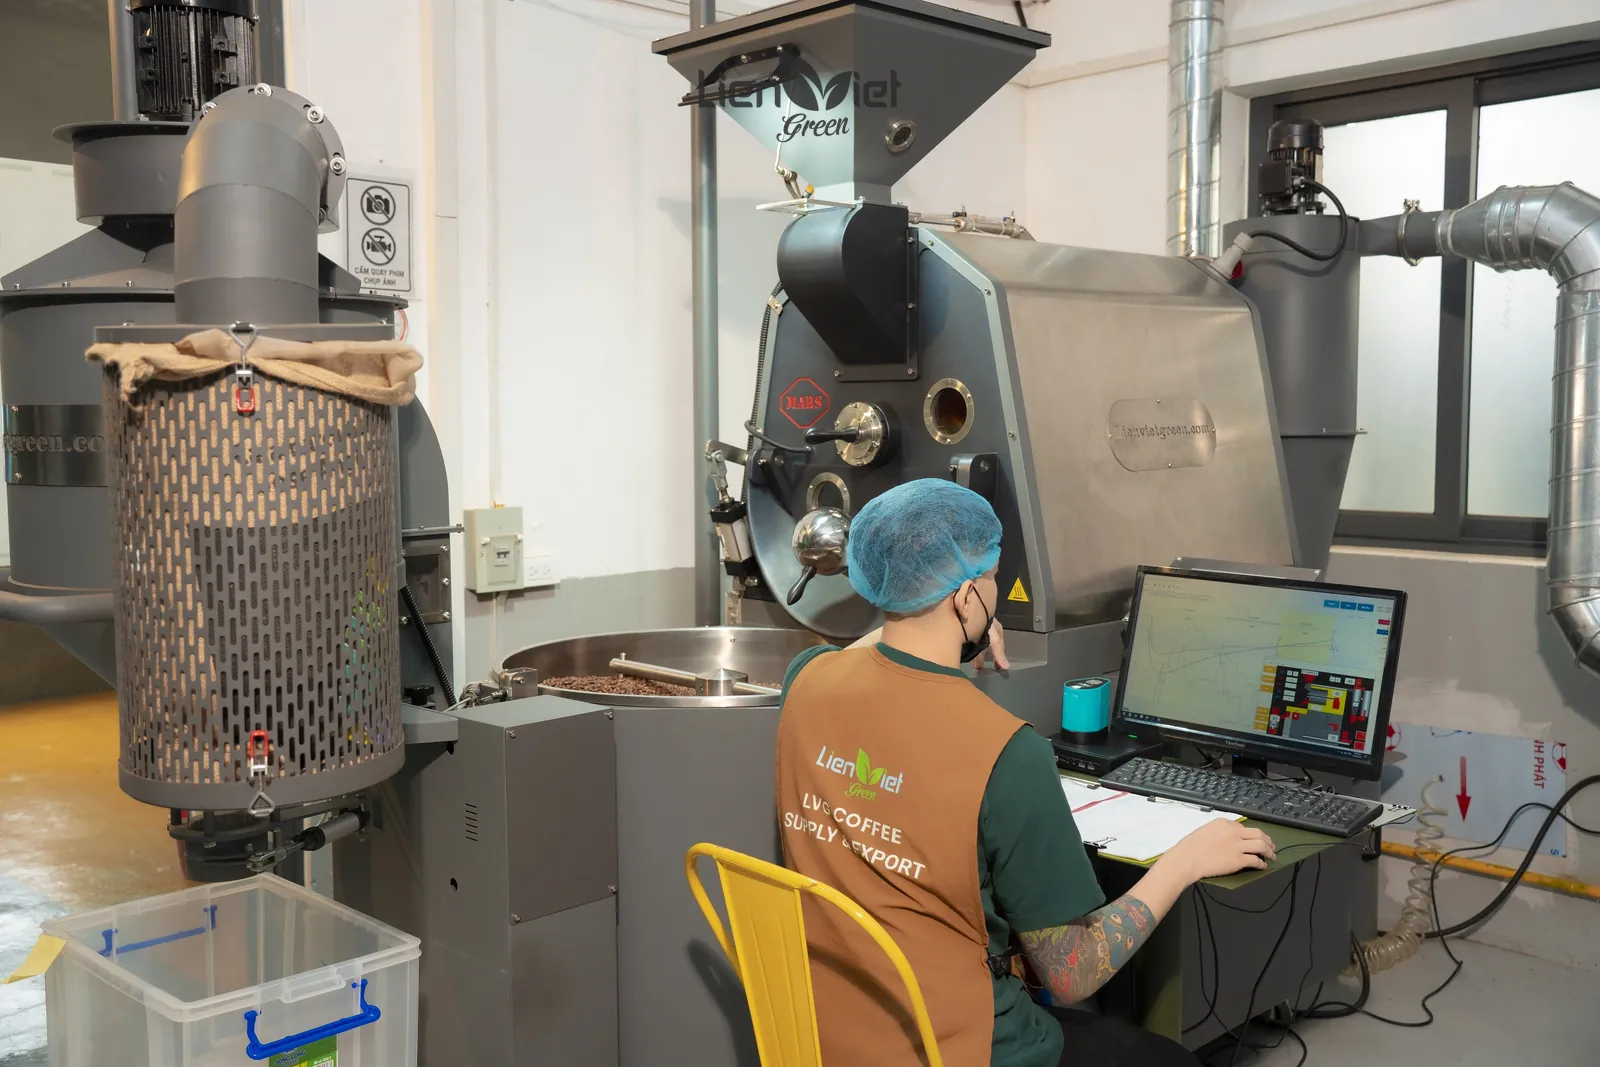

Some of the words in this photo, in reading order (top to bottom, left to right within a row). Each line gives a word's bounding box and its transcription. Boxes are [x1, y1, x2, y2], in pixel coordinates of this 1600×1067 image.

[776, 113, 850, 143] Green
[785, 395, 823, 410] MARS
[1533, 756, 1547, 789] PHÁT
[844, 783, 877, 800] Green
[833, 807, 902, 845] COFFEE
[784, 812, 838, 843] SUPPLY
[852, 840, 926, 879] EXPORT
